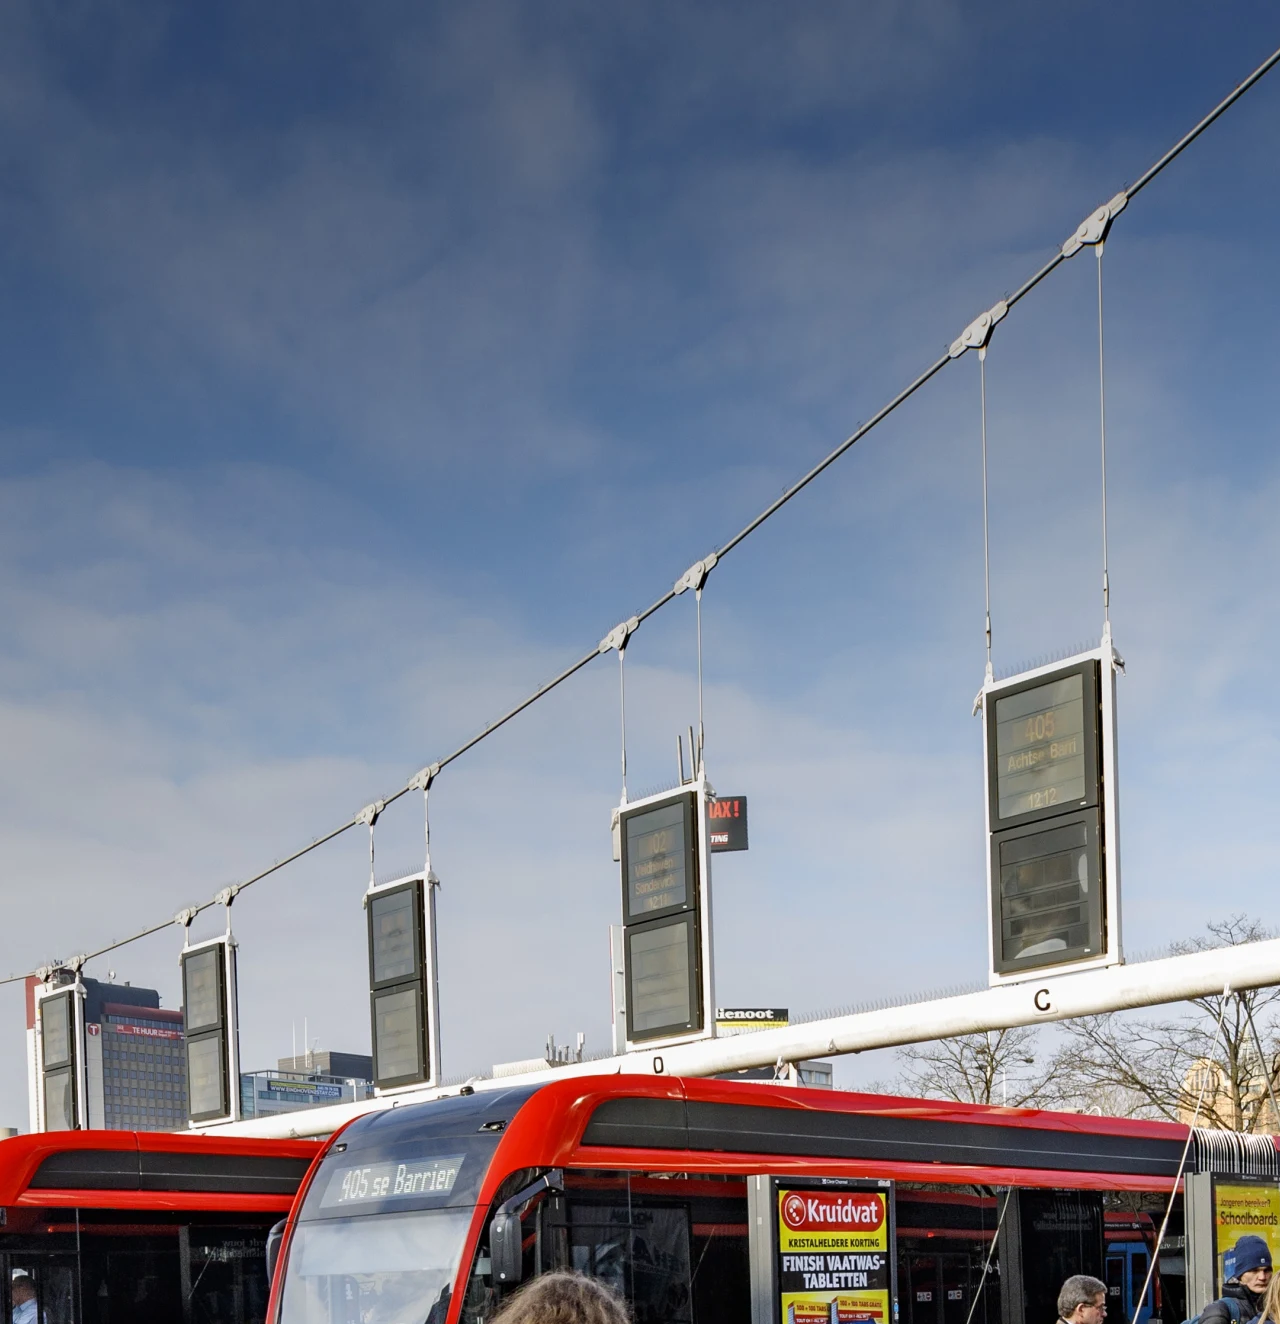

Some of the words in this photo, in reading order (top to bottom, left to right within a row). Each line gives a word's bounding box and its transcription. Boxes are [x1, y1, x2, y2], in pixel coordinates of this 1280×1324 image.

[710, 834, 728, 843] TING
[1034, 988, 1051, 1012] C
[132, 1026, 140, 1034] TE
[140, 1027, 158, 1036] HUUR
[341, 1168, 372, 1200] 405
[371, 1176, 390, 1196] se
[393, 1163, 456, 1194] Barrier
[808, 1198, 878, 1223] Kruidvat
[1220, 1199, 1244, 1208] Jongeren
[1220, 1211, 1278, 1226] Schoolboards
[788, 1238, 848, 1248] KRISTALHELDERE
[850, 1238, 880, 1248] KORTING
[783, 1255, 825, 1272] FINISH
[826, 1255, 886, 1272] VAATWAS-
[803, 1272, 868, 1289] TABLETTEN
